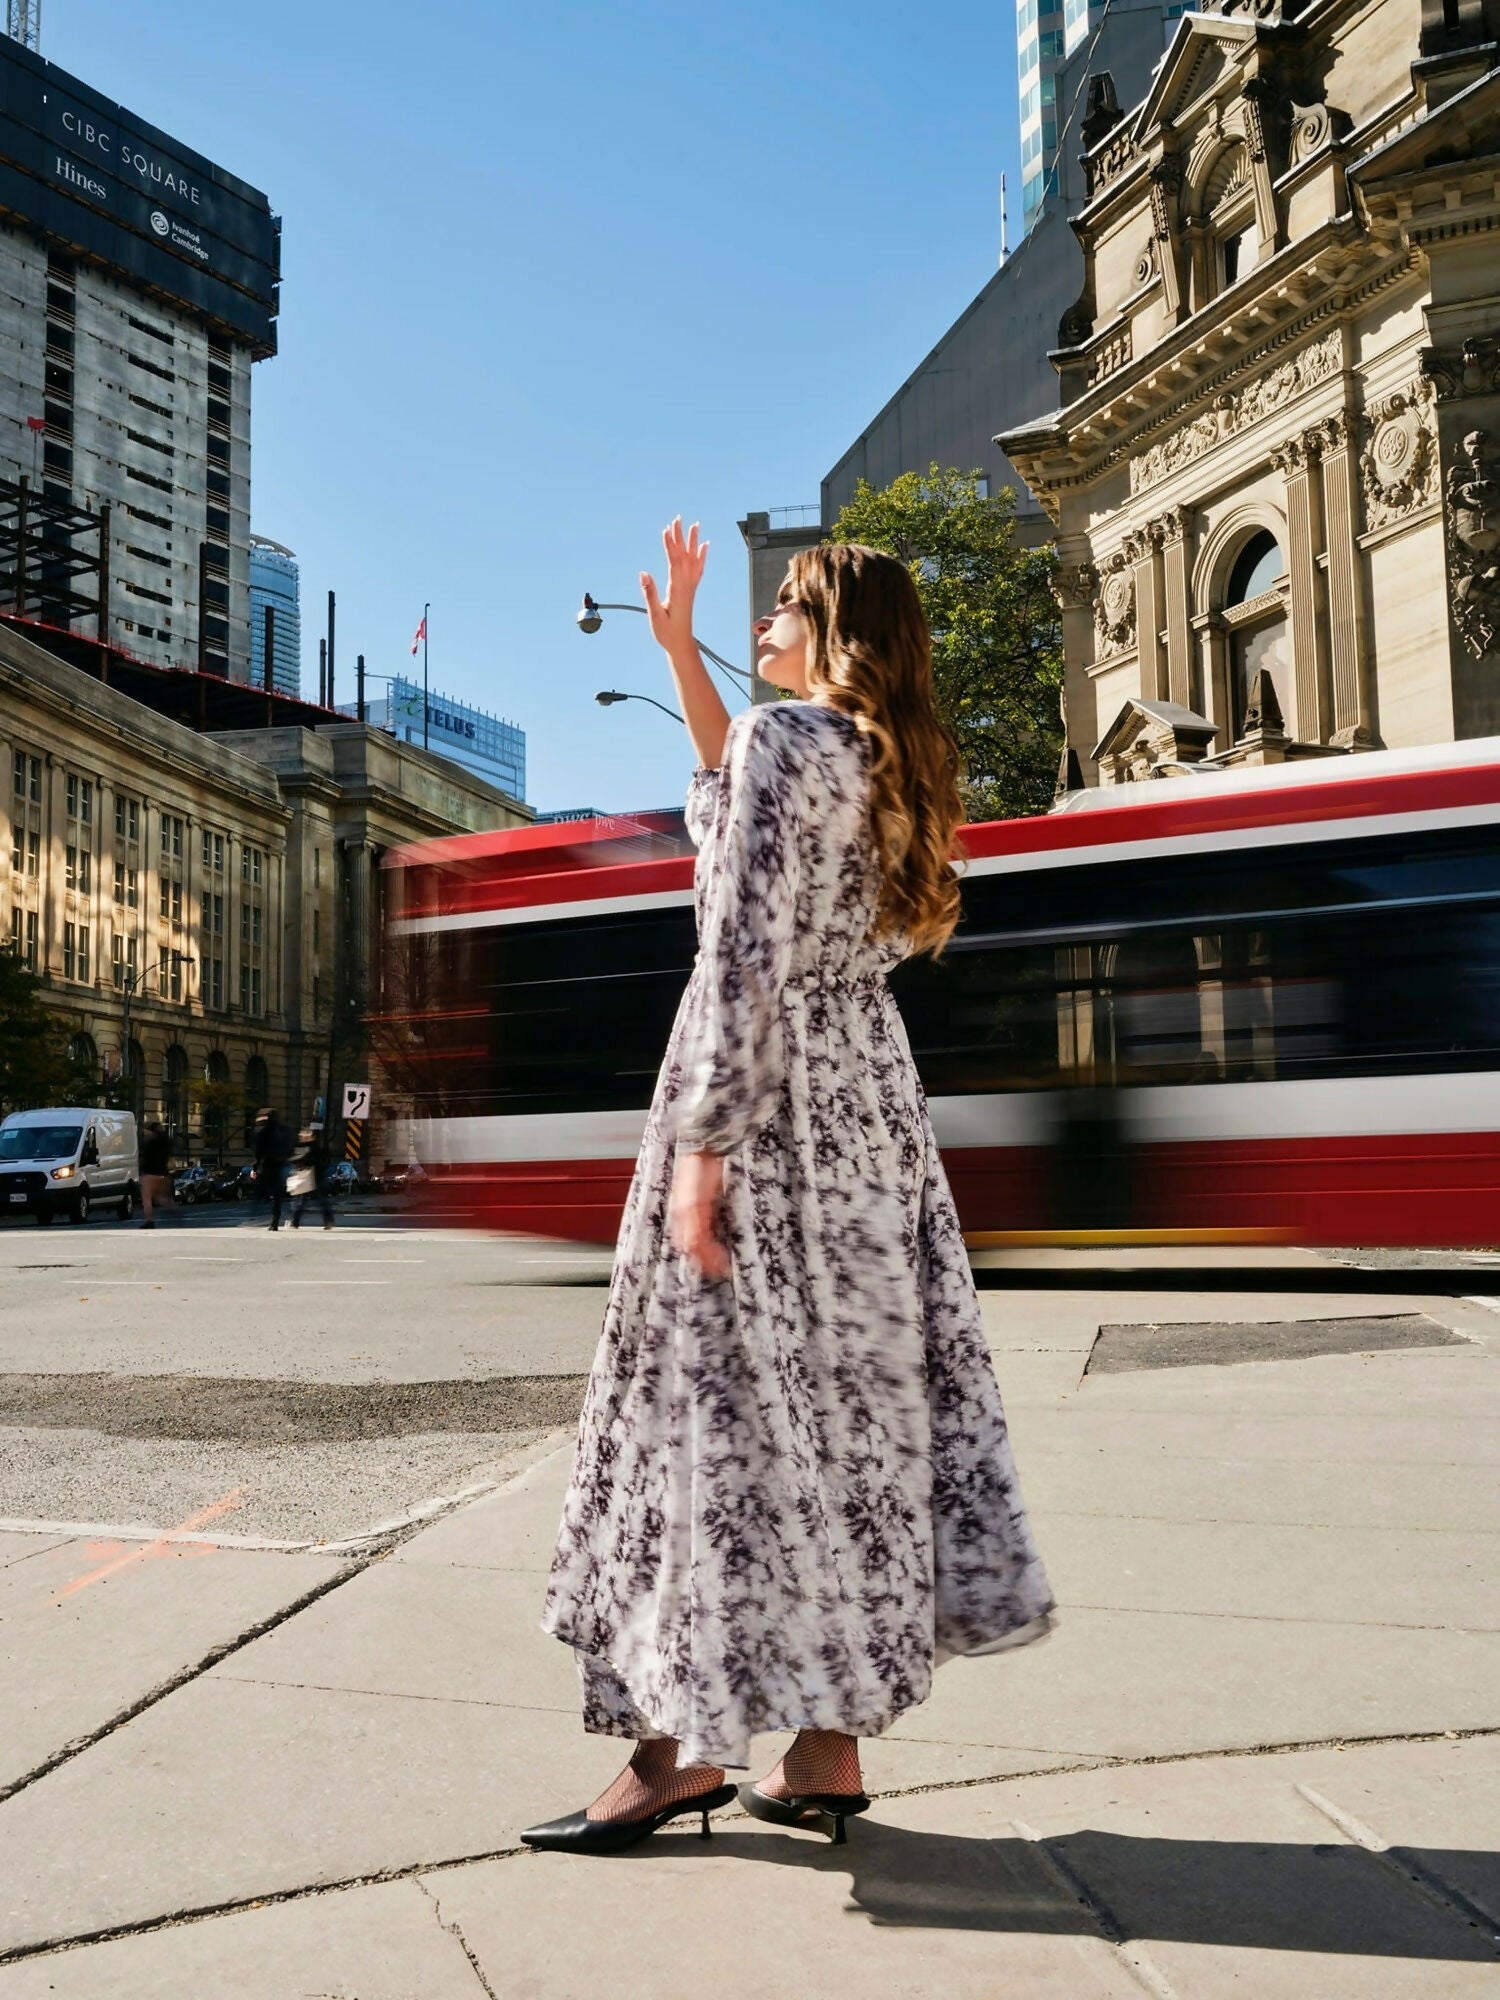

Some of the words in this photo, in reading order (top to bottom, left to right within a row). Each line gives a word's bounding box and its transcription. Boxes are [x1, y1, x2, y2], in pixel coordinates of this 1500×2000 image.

[62, 112, 110, 152] CIBC
[121, 146, 200, 205] SQUARE
[56, 156, 107, 199] Hines
[171, 233, 209, 260] Cambridge
[172, 221, 200, 244] Ivanhoé
[427, 706, 476, 739] TELUS
